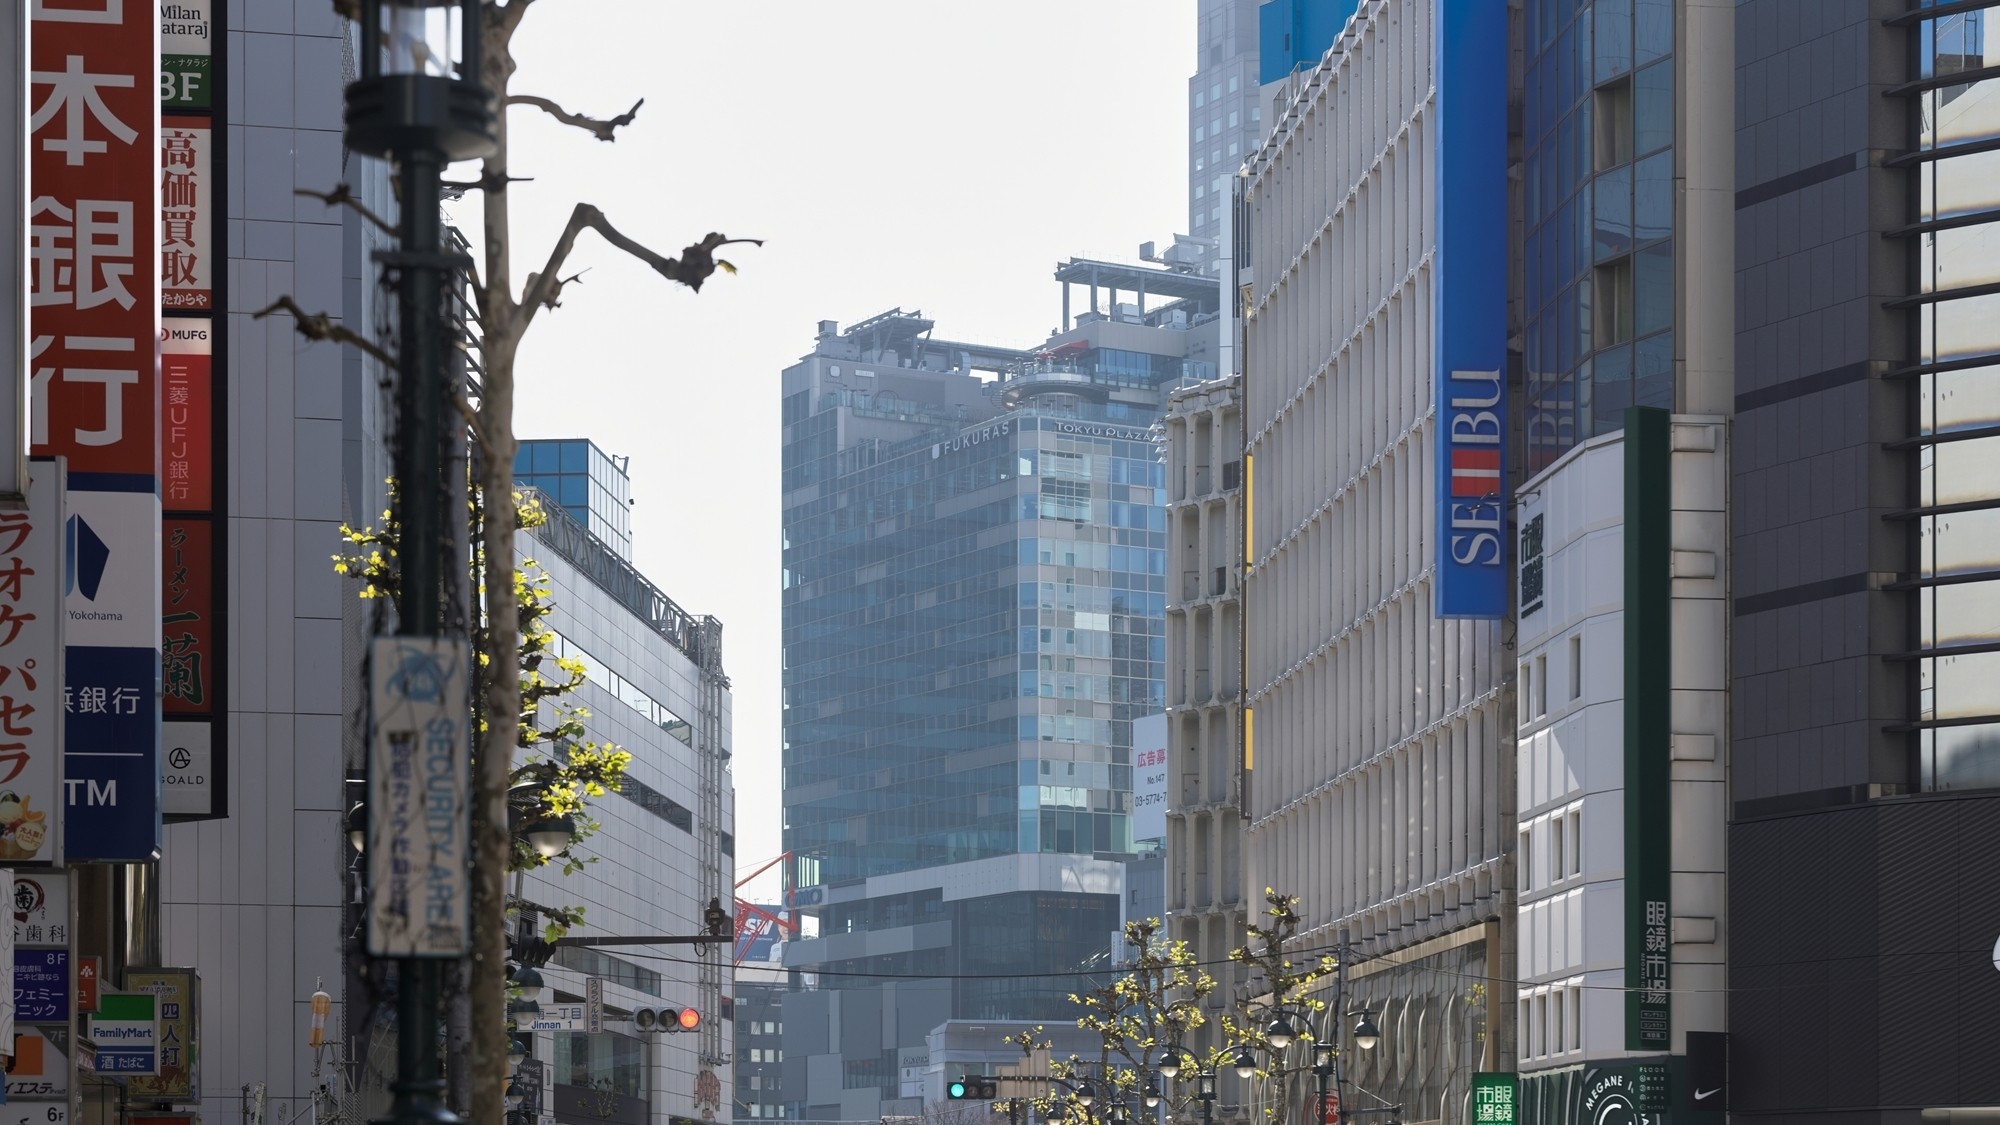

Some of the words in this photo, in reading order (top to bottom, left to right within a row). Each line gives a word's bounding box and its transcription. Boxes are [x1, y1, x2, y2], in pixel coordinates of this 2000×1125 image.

[161, 5, 201, 20] Milan
[161, 130, 198, 287] 高価買取
[31, 0, 140, 447] 本銀行
[162, 293, 208, 306] たからや
[172, 330, 207, 340] MUFG
[169, 365, 189, 500] 三菱UFJ銀行
[944, 421, 1010, 455] FUKURAS
[1056, 421, 1101, 436] TOKYU
[1106, 427, 1151, 442] PLAZA
[1451, 368, 1500, 566] SEIBU
[169, 527, 189, 605] ラーメン
[69, 610, 123, 621] Yokohama
[0, 478, 37, 785] ラオケパセラ
[426, 719, 455, 858] SECURITY
[426, 859, 455, 941] ARE
[47, 953, 66, 965] 8F
[1646, 900, 1666, 1004] 眼鏡市場
[49, 1030, 67, 1042] 7F
[93, 1027, 152, 1039] FamilyMart
[531, 1020, 561, 1029] Jinnan
[567, 1020, 573, 1029] 1
[101, 1055, 114, 1070] 酒
[118, 1056, 145, 1069] たばこ
[1585, 1075, 1623, 1111] MEGANE
[47, 1107, 64, 1122] 6F
